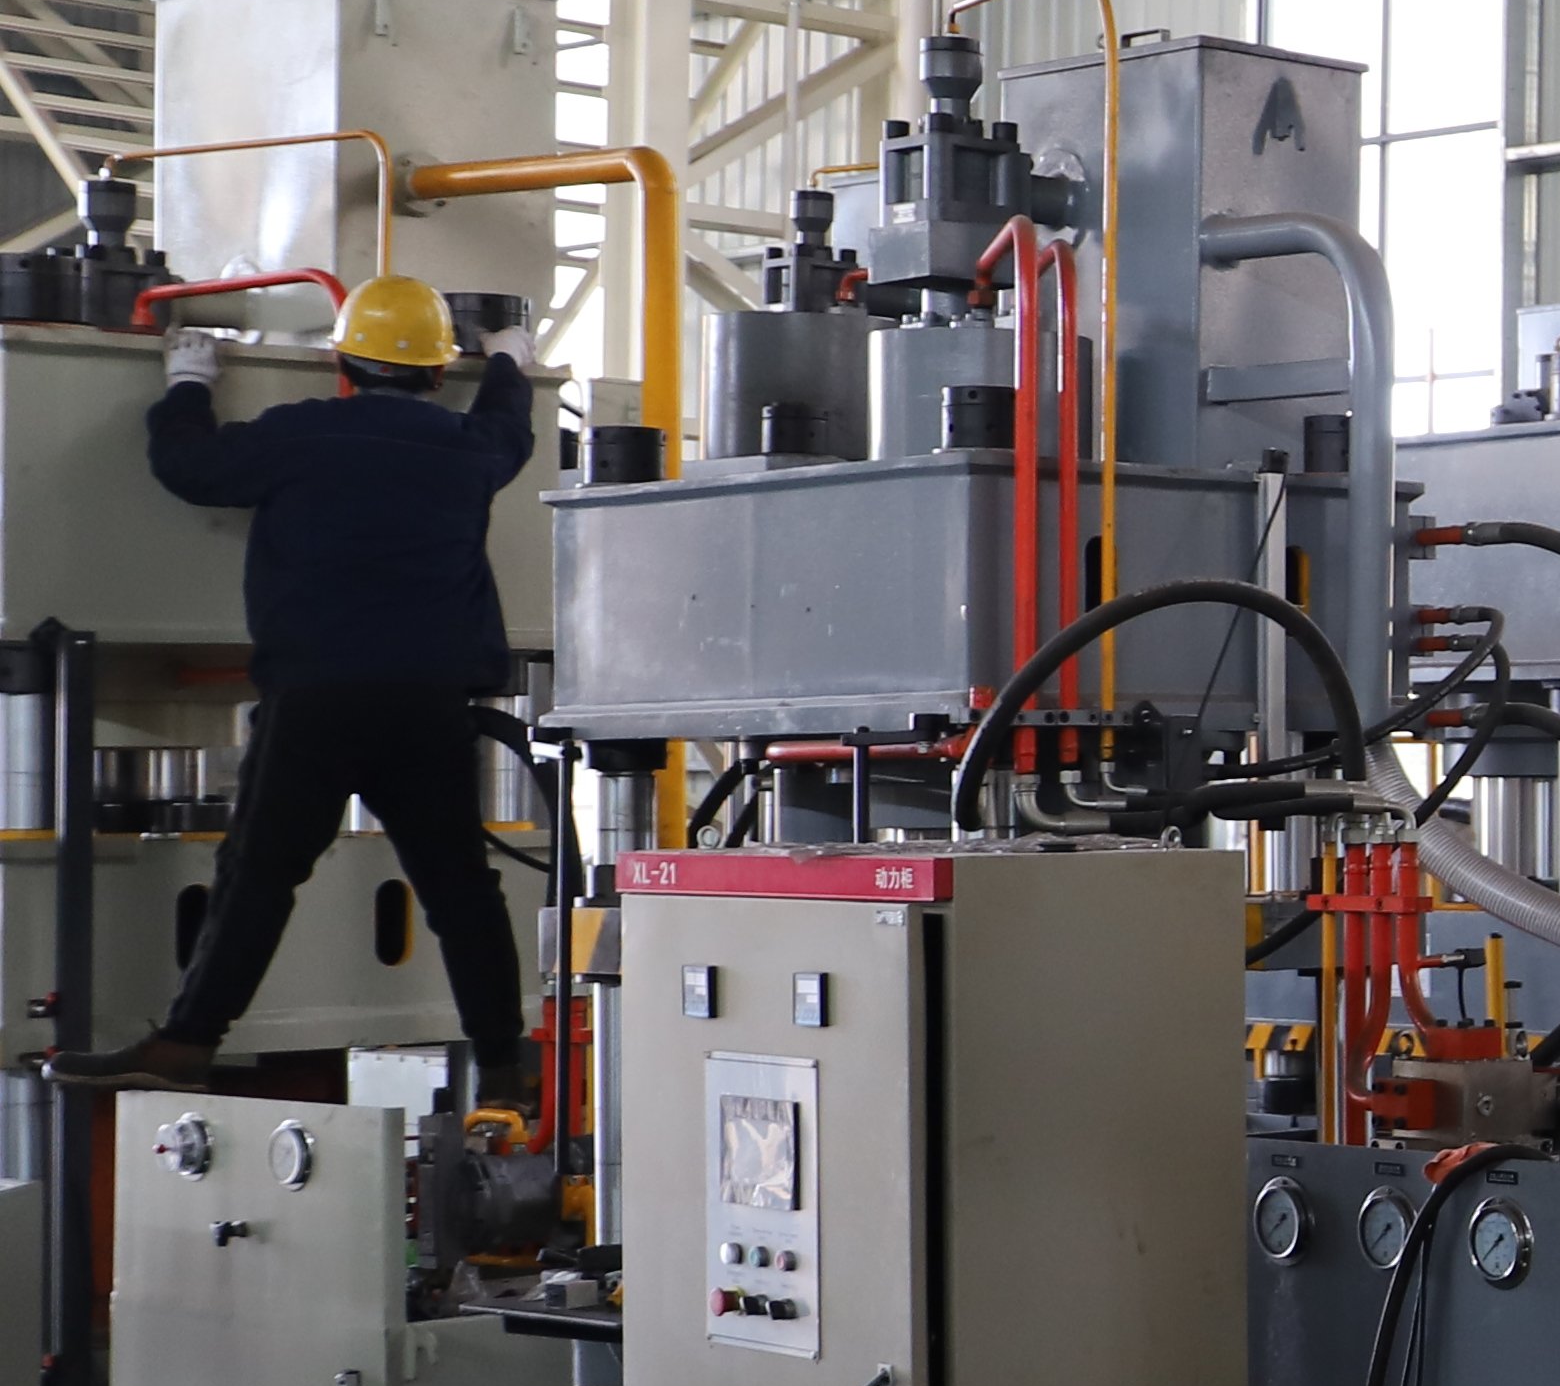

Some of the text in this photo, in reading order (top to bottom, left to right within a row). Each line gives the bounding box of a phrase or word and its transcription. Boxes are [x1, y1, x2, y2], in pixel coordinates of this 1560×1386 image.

[632, 860, 677, 886] XL-21
[874, 866, 914, 890] 动力柜
